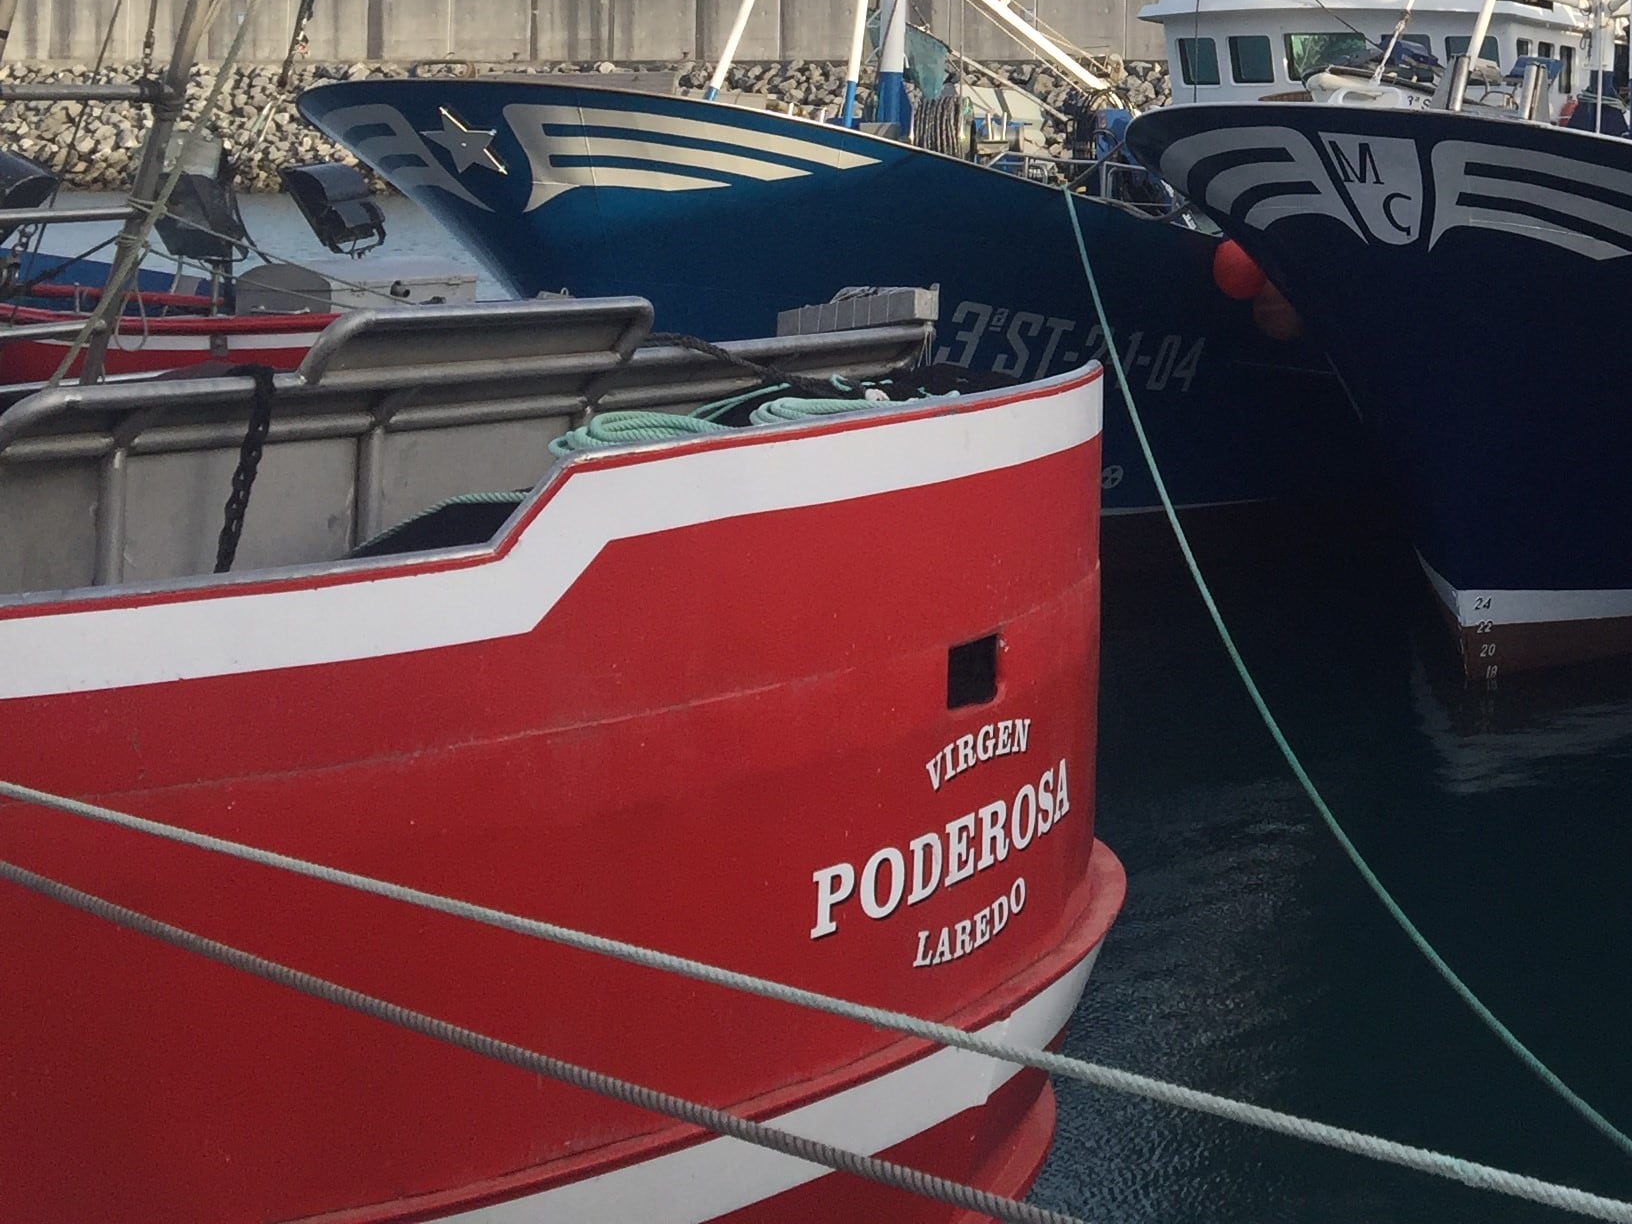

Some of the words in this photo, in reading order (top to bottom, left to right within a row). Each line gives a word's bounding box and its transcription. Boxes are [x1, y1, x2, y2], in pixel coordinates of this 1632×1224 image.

[1328, 140, 1385, 185] M
[1382, 192, 1412, 236] C
[1474, 597, 1492, 610] 24
[1480, 643, 1496, 657] 20
[1486, 665, 1498, 678] 18
[925, 718, 1031, 791] VIRGEN
[809, 758, 1071, 940] PODEROSA
[912, 877, 1026, 967] LAREDO
